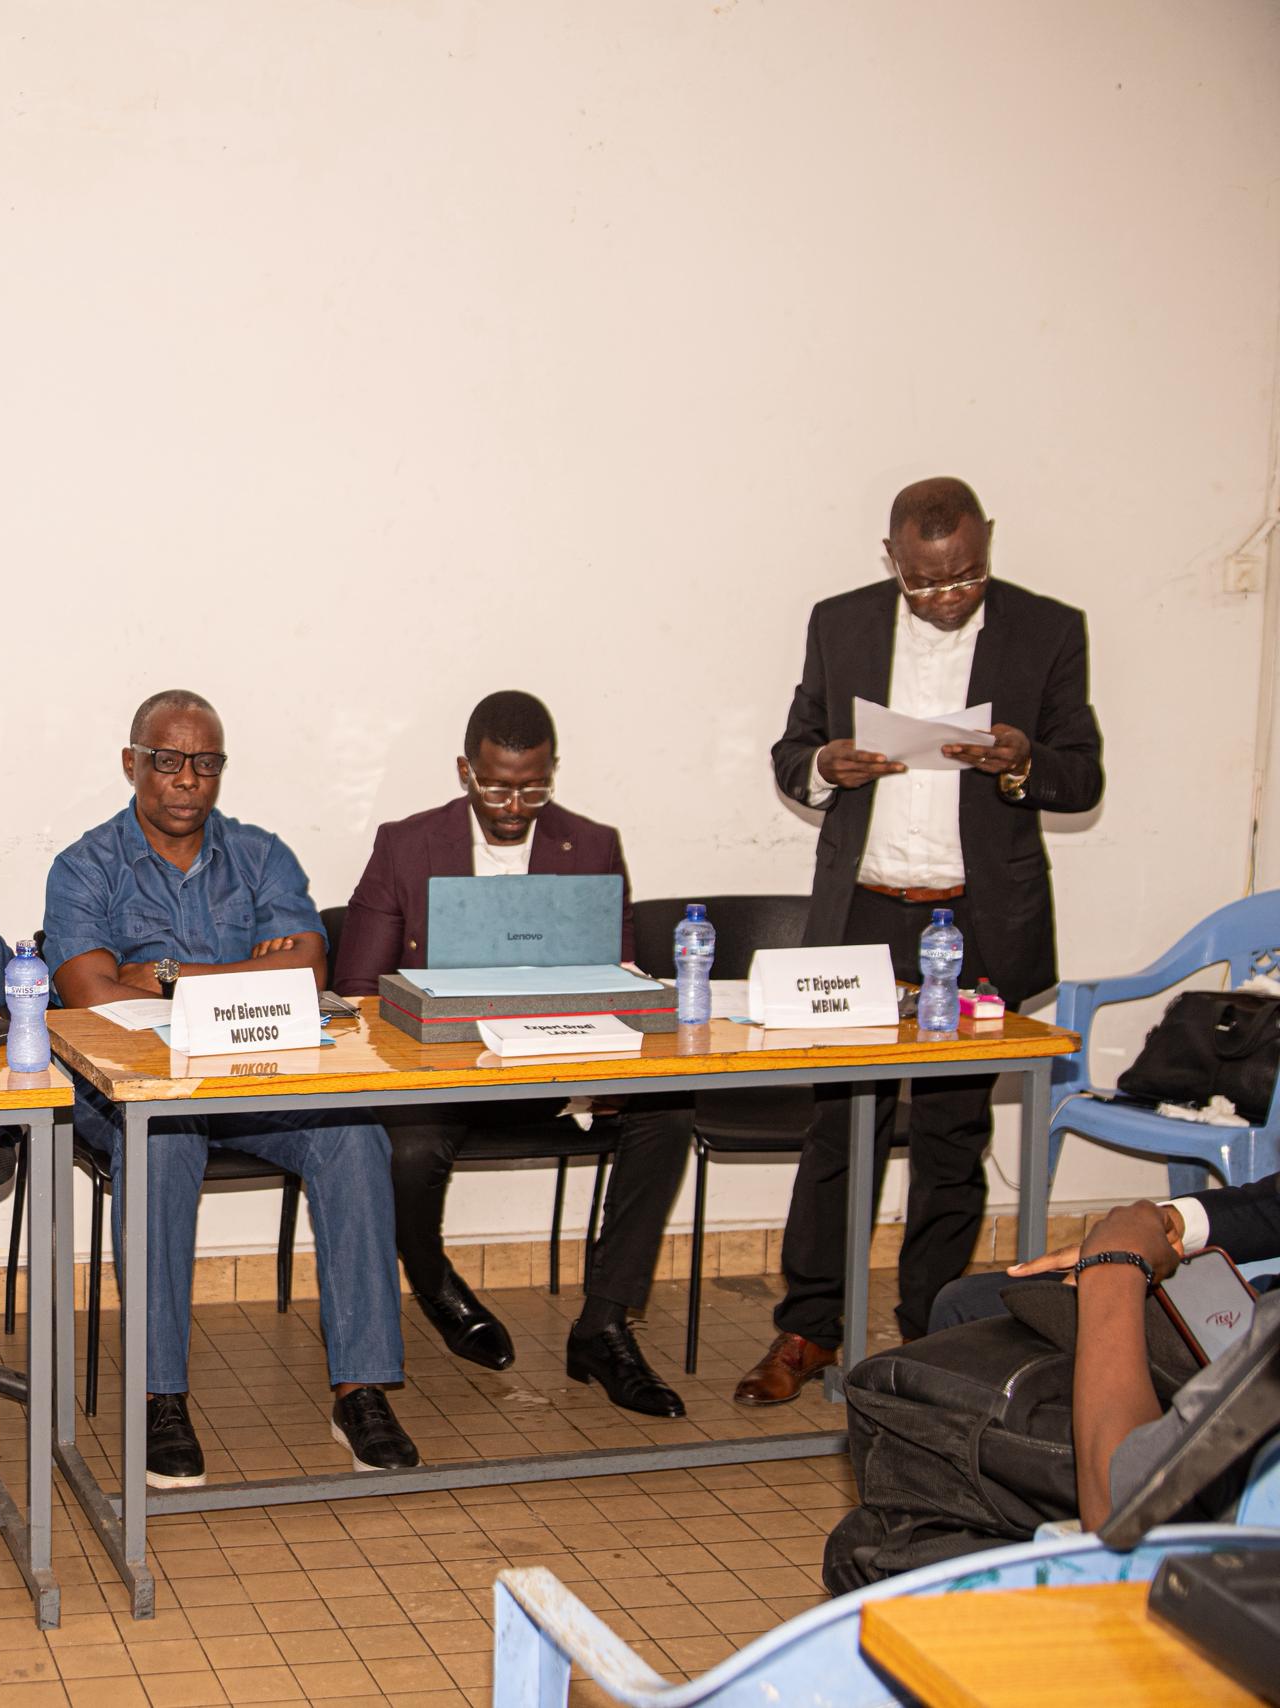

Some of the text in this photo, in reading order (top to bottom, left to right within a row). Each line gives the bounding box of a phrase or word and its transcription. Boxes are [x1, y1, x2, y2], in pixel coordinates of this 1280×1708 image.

[507, 932, 543, 941] Lenovo
[796, 975, 860, 995] CT Rigobert
[213, 1002, 291, 1021] Prof Bienvenu
[812, 998, 850, 1014] MBIMA
[230, 1025, 279, 1044] MUKOSO
